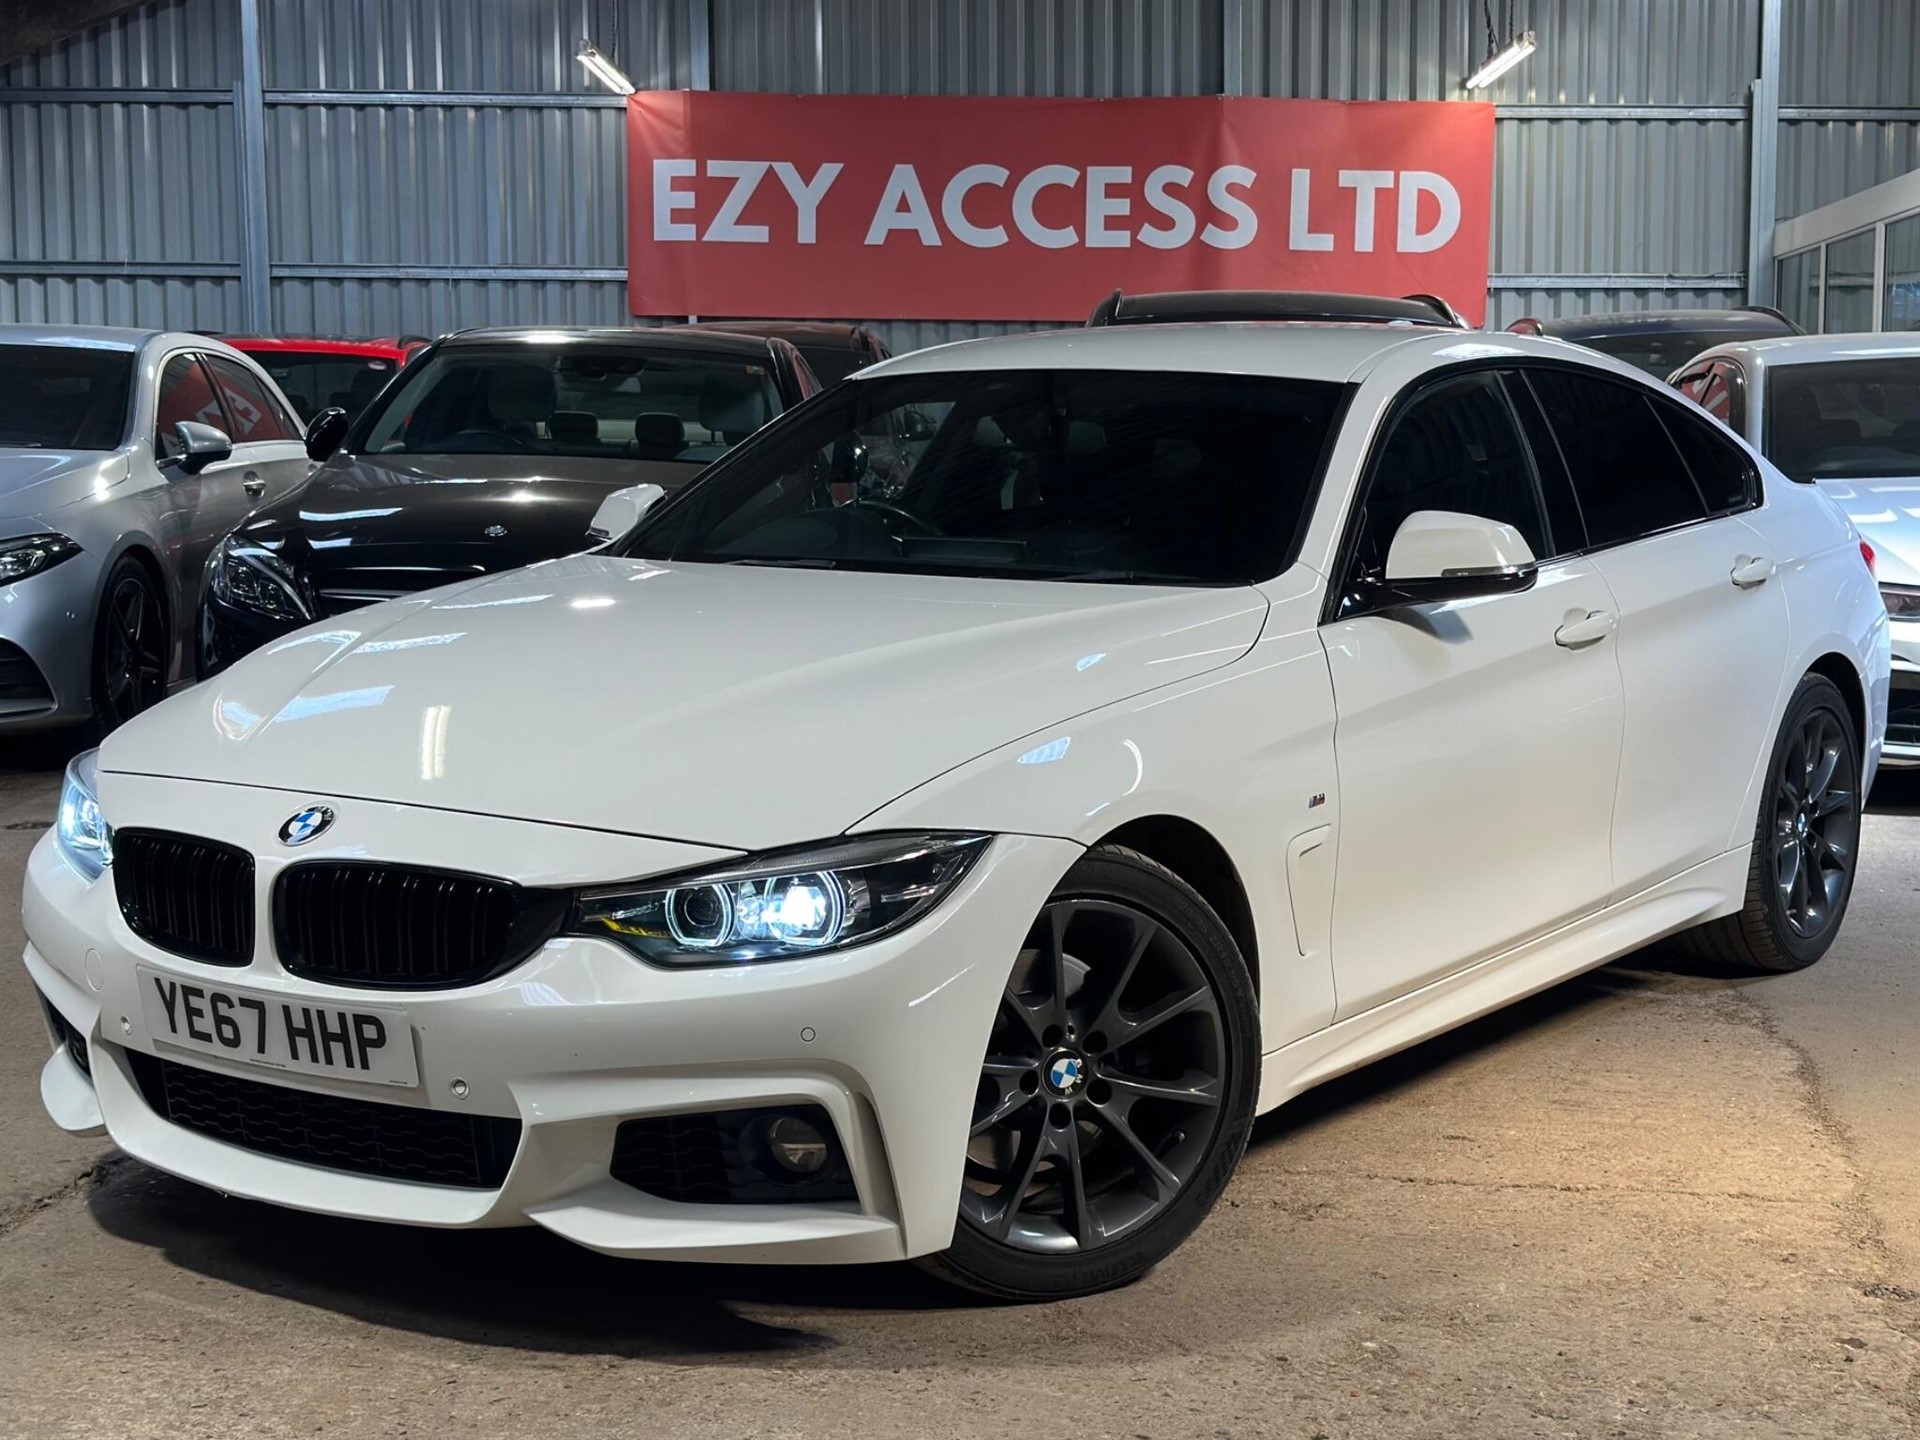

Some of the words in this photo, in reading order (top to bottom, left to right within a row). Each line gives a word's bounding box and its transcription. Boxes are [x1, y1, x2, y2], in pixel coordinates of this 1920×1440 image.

[652, 158, 844, 244] EZY
[864, 164, 1259, 249] ACCESS
[1288, 167, 1462, 253] LTD
[154, 976, 267, 1055] YE67
[282, 1005, 387, 1070] HHP
